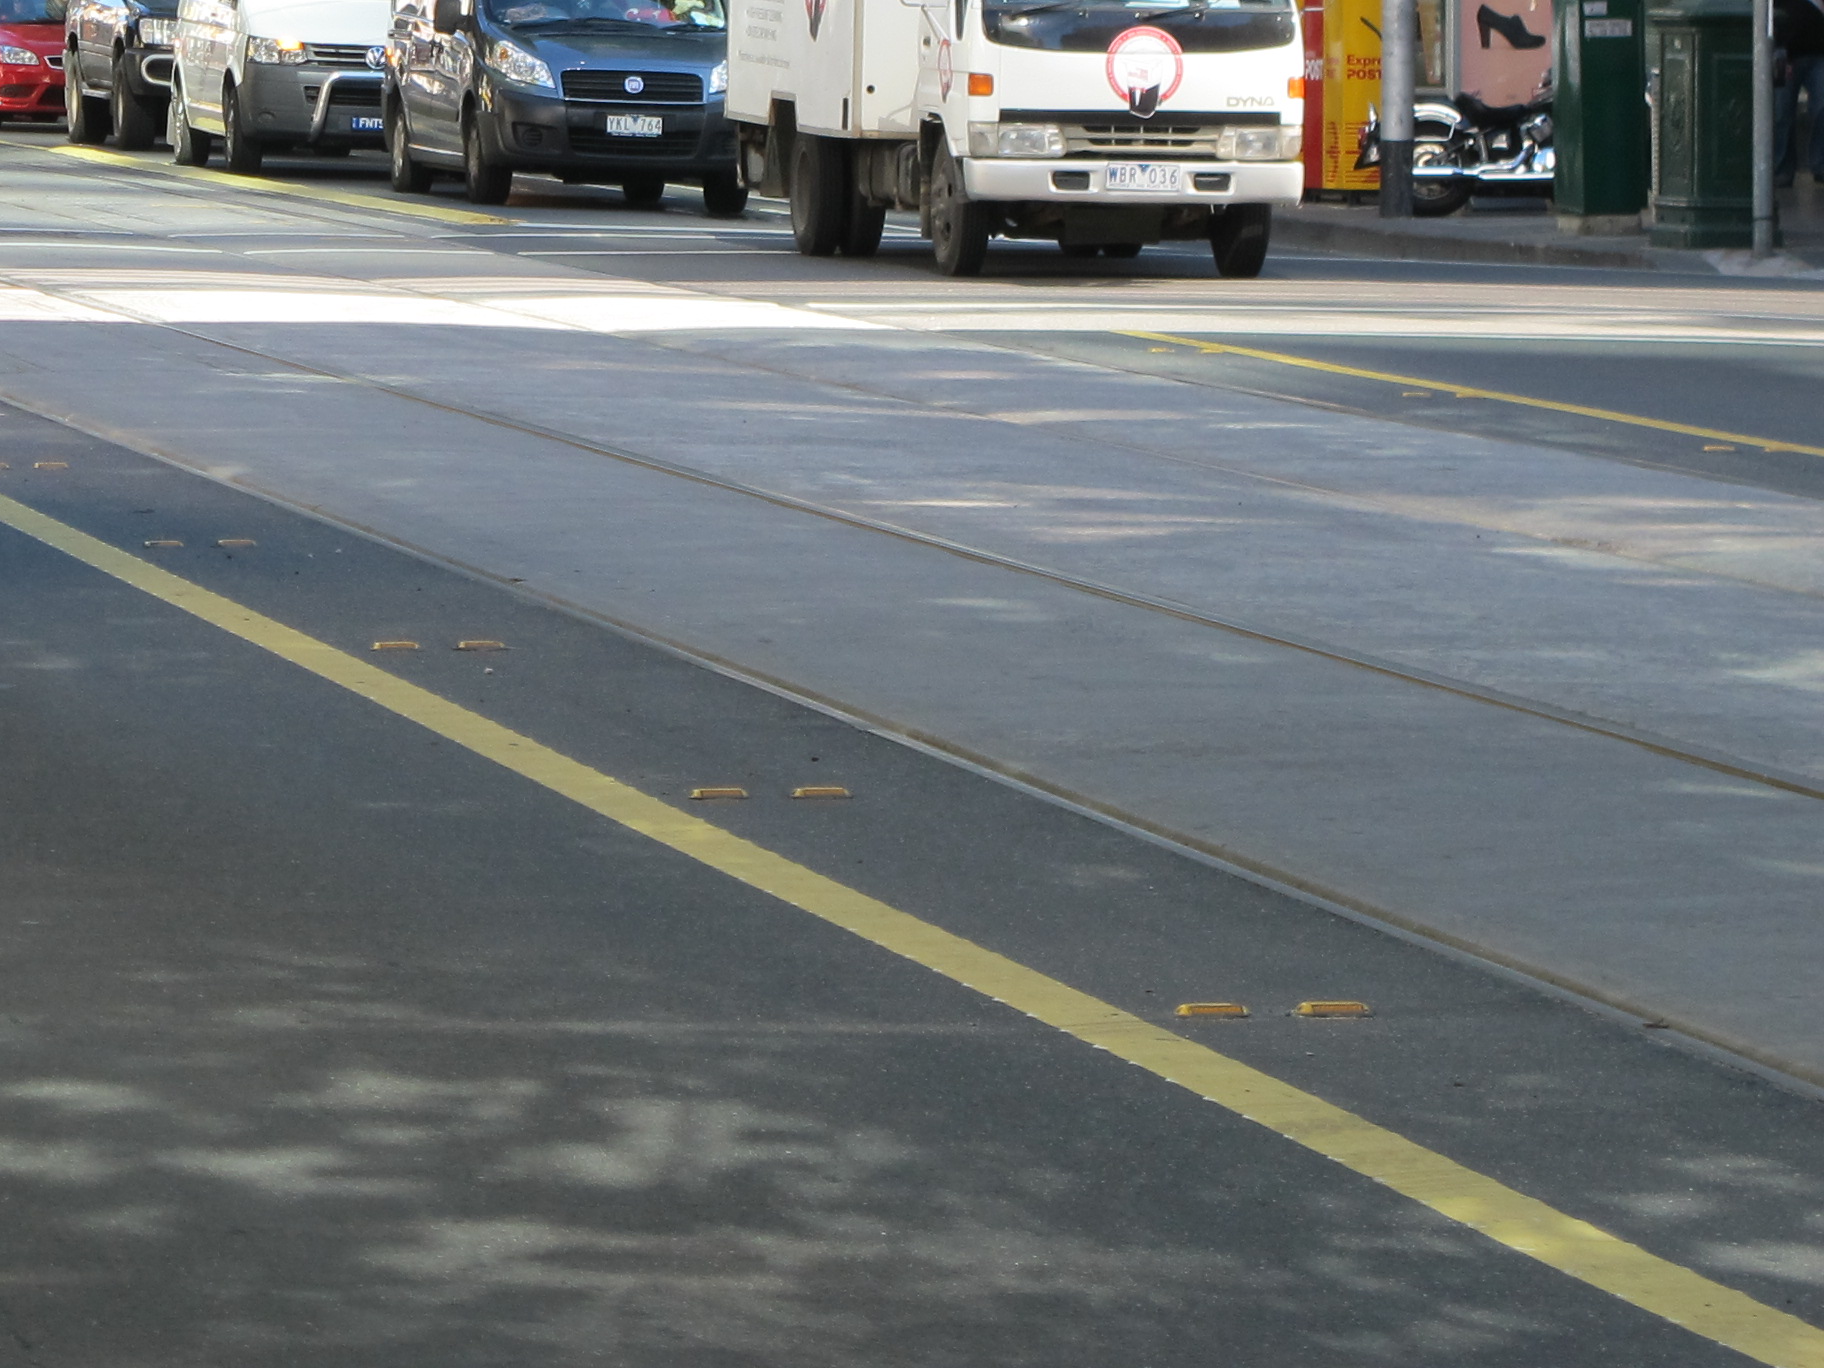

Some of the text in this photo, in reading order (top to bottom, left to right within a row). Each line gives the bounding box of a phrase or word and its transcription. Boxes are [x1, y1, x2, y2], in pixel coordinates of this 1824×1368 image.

[1226, 97, 1276, 107] DYNA
[609, 117, 663, 132] YKL 764
[1108, 167, 1178, 185] WBR 036
